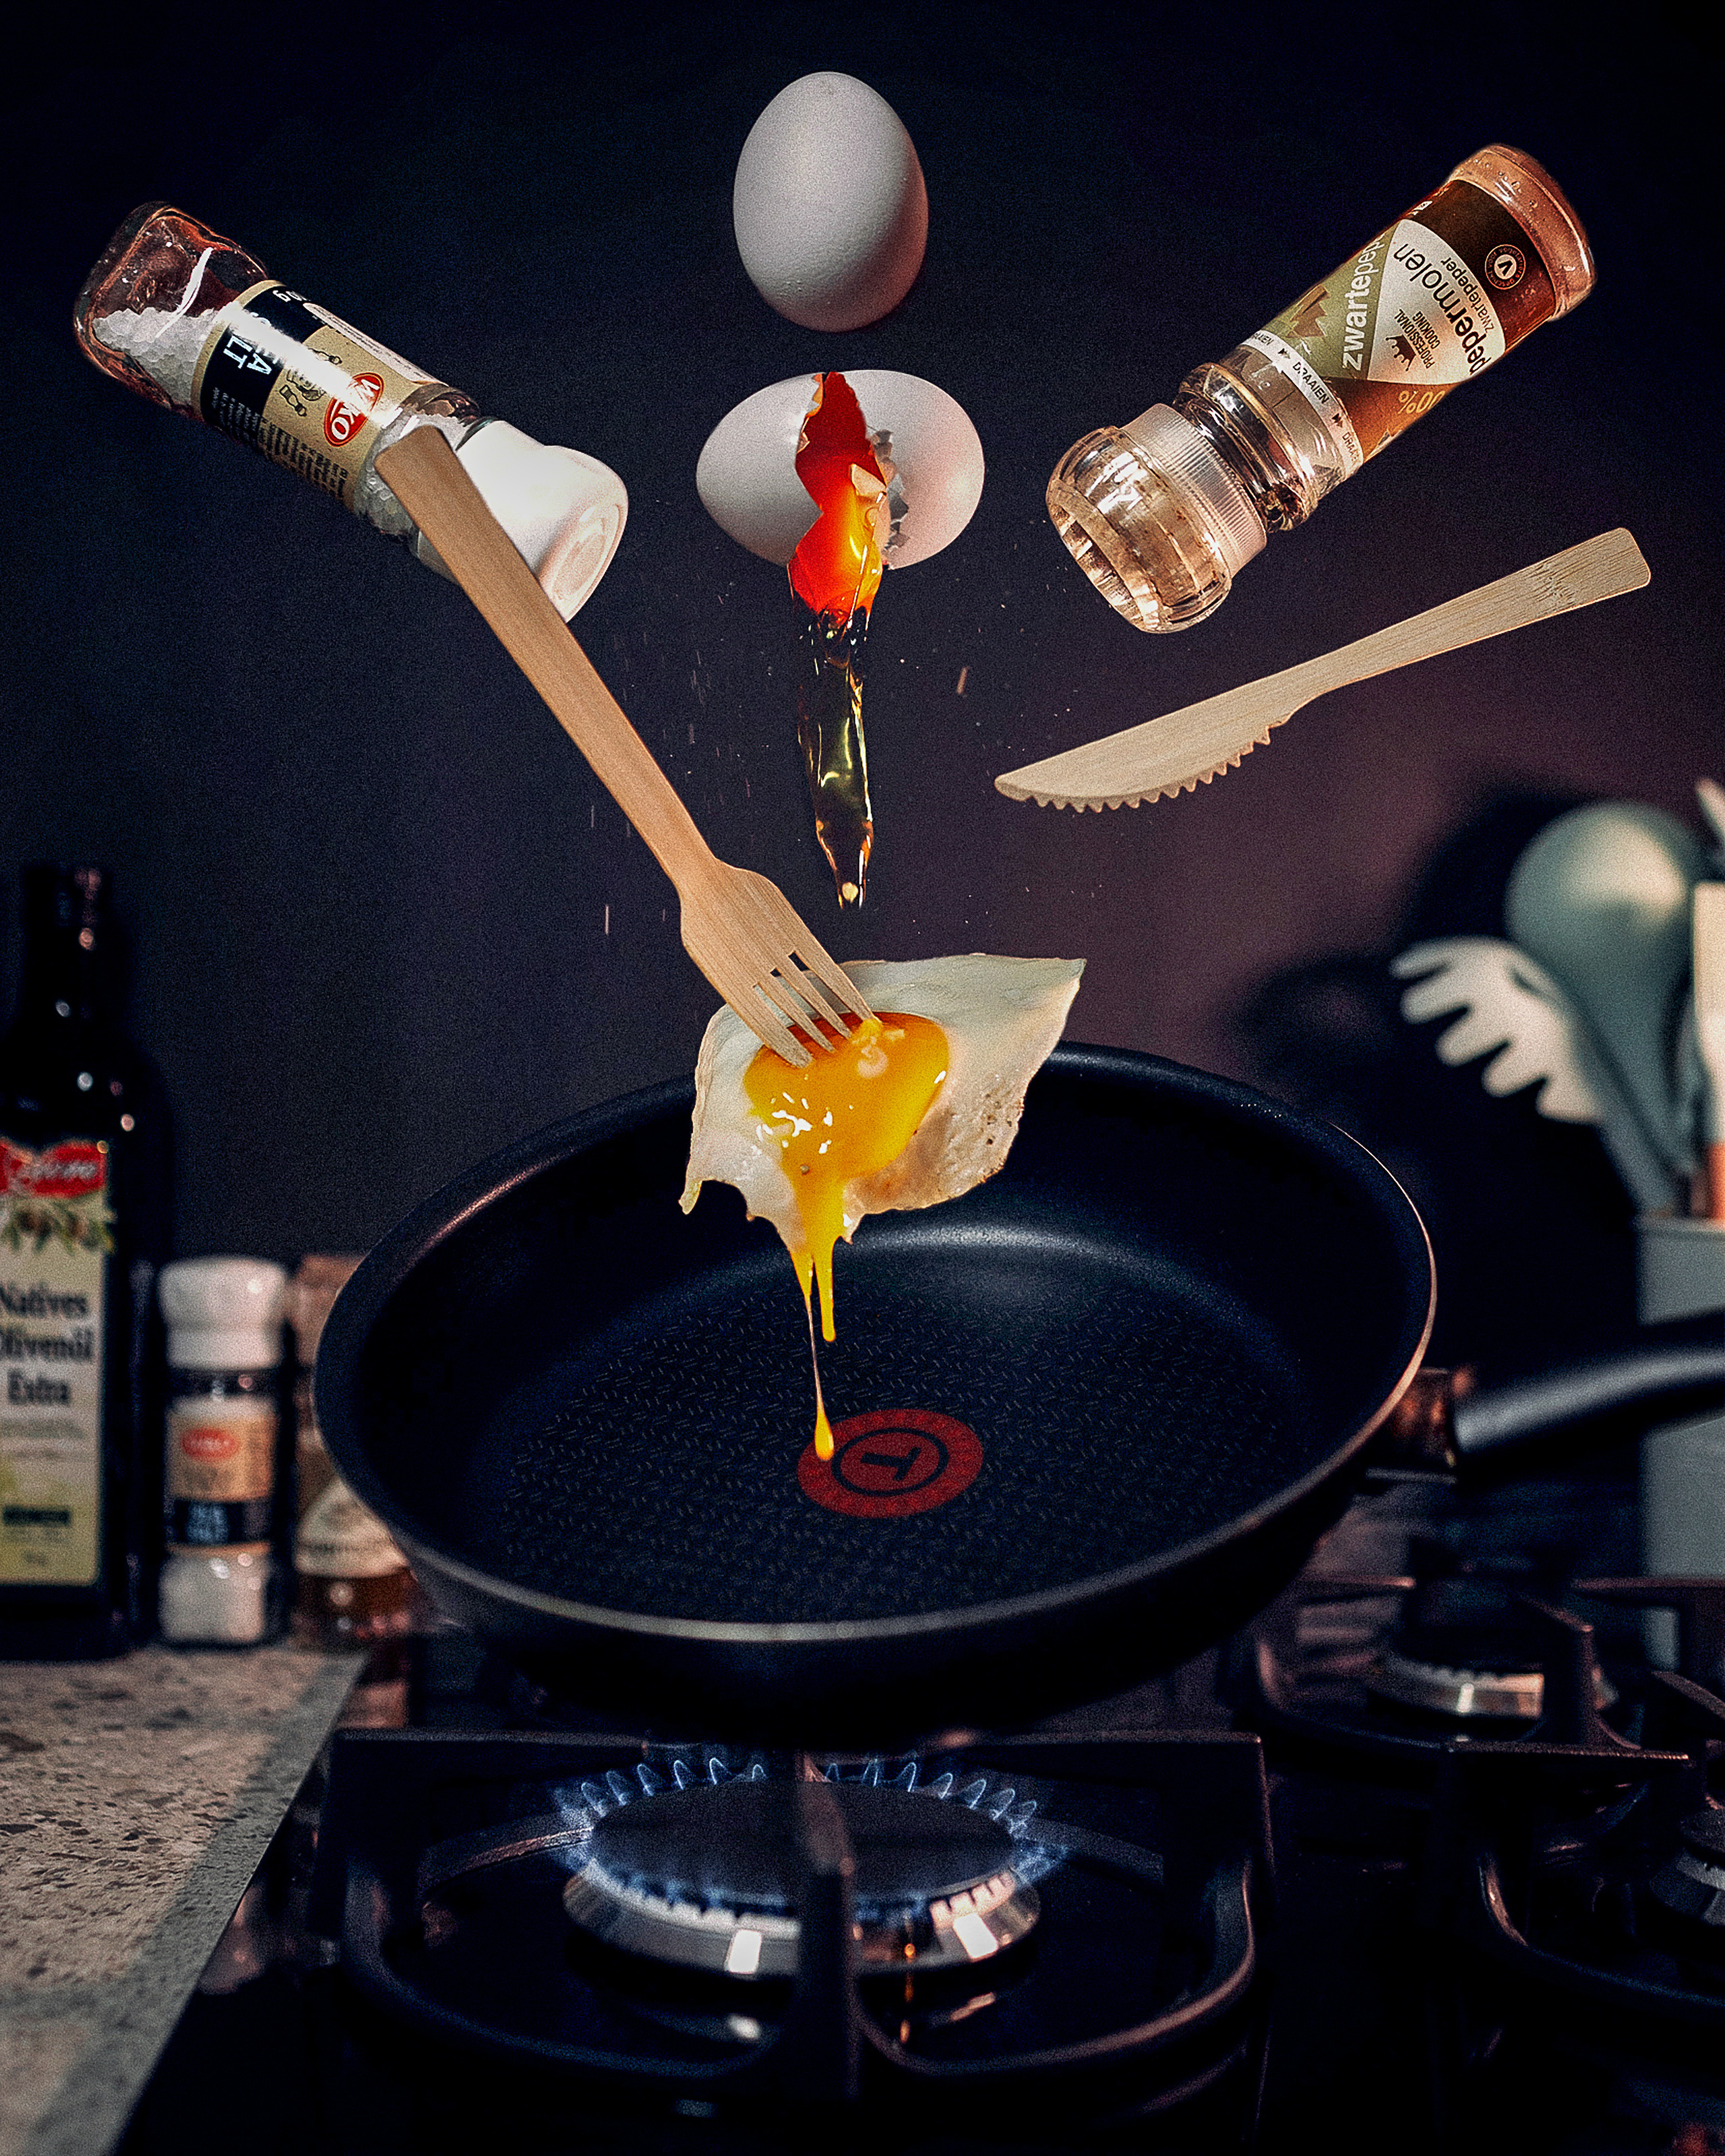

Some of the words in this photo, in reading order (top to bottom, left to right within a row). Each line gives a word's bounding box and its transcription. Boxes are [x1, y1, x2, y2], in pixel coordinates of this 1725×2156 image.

[1497, 259, 1513, 277] V
[1393, 243, 1491, 375] pepermolen
[1441, 257, 1495, 334] zwartepeper
[222, 311, 272, 370] SLT
[1394, 309, 1436, 369] PROFESSIONAL
[1412, 311, 1441, 349] COOKING
[1292, 361, 1330, 405] DRAAIEN
[331, 378, 381, 441] WKO
[0, 1325, 94, 1363] livenöl
[8, 1369, 70, 1405] Extra
